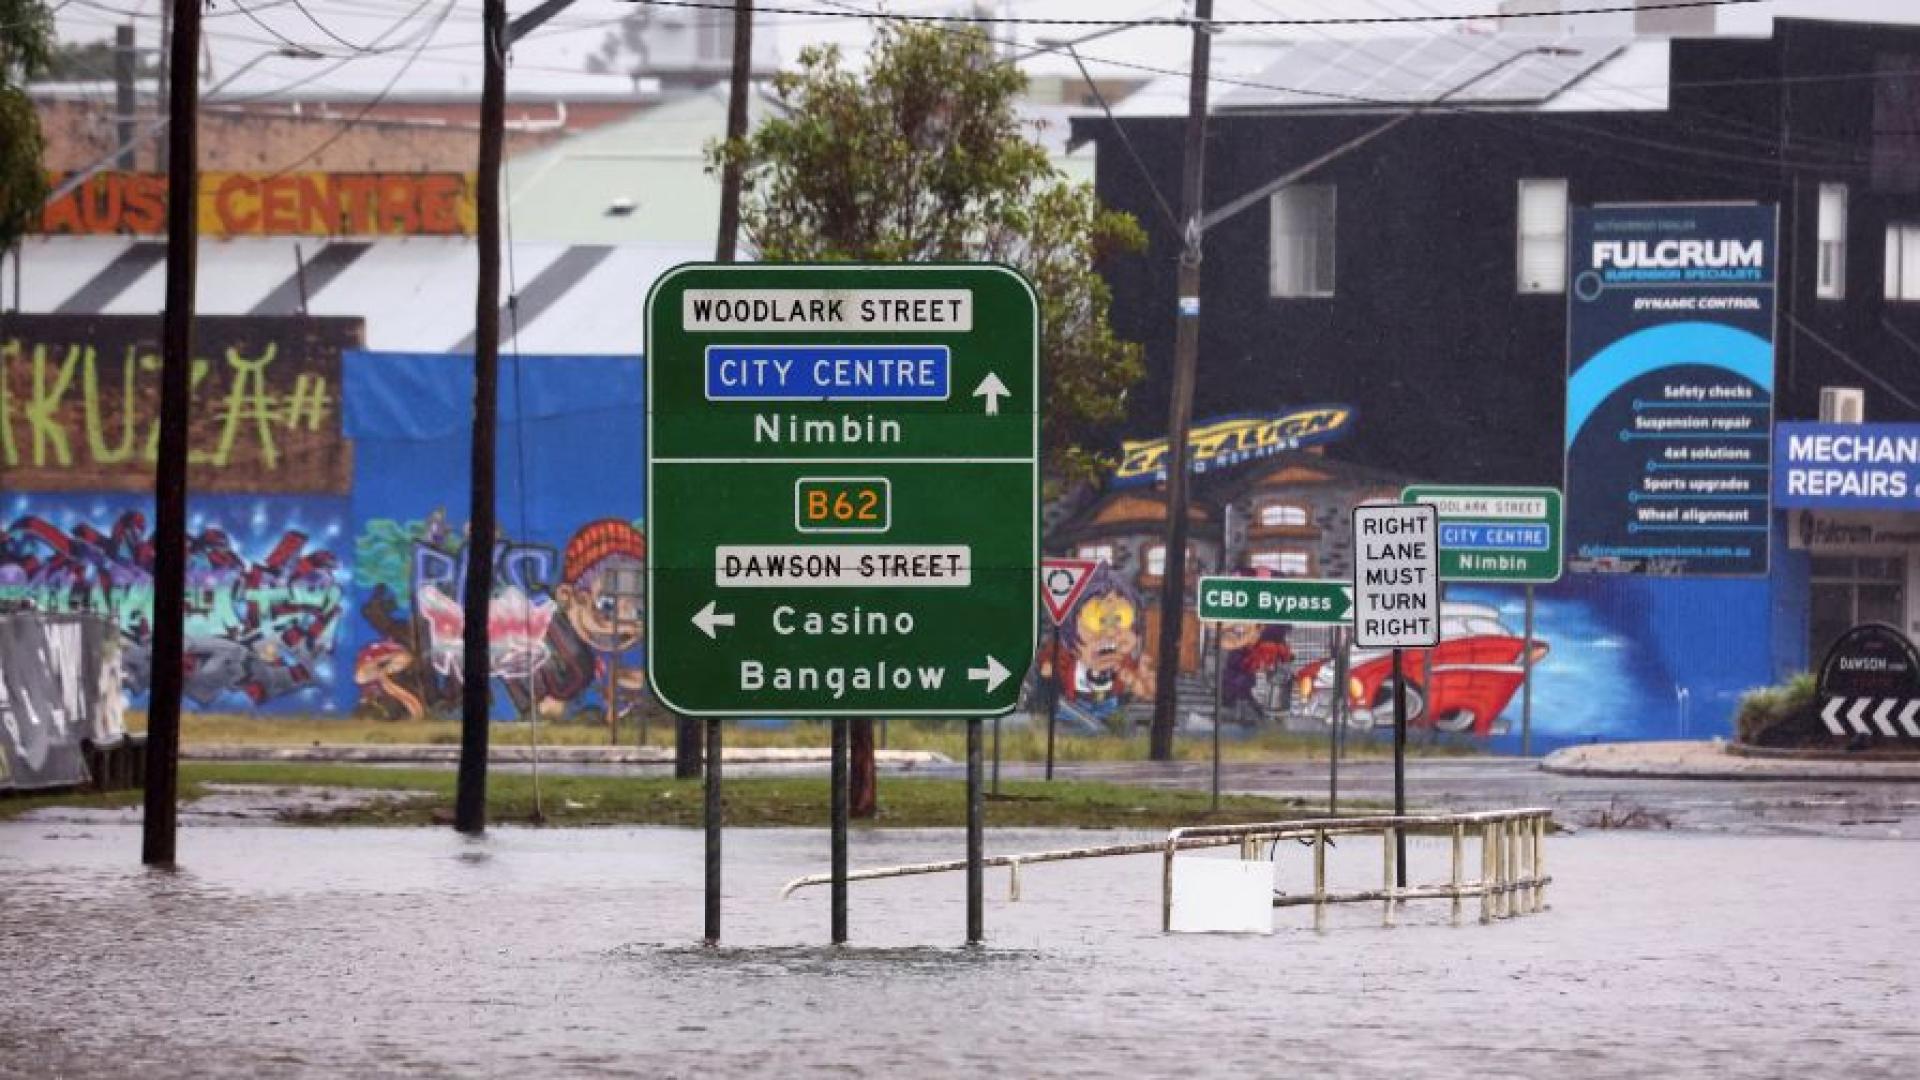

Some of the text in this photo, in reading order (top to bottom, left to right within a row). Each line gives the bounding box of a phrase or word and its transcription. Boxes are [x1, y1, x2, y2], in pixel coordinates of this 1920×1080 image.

[214, 172, 460, 234] CENTRE
[1592, 239, 1763, 268] FULCRUM
[693, 298, 963, 323] WOODLARK STREET
[1633, 297, 1760, 310] DYNAMIC CONTROL
[719, 359, 936, 387] CITY CENTRE
[1664, 385, 1752, 401] Safety checks
[754, 413, 901, 443] Nimbin
[1634, 415, 1752, 431] Suspension repair
[1664, 447, 1750, 460] 4x4 solutions
[1788, 434, 1920, 464] MECHAN
[1643, 477, 1749, 493] Sports upgrades
[1788, 469, 1907, 498] REPAIRS
[807, 490, 879, 521] B62
[1436, 501, 1543, 513] ODLARK STREET
[1637, 508, 1749, 523] Wheel alignment
[1363, 516, 1428, 535] RIGHT
[1443, 528, 1543, 543] CITY CENTRE
[1366, 541, 1428, 560] LANE
[725, 554, 963, 577] DAWSON STREET
[1458, 554, 1527, 571] Nimbin
[1366, 567, 1428, 585] MUST
[1206, 590, 1332, 614] CBD Bypass
[1366, 592, 1426, 611] TURN
[772, 605, 915, 635] Casino
[1365, 616, 1430, 636] RIGHT
[1840, 657, 1887, 670] DAWSON
[740, 660, 946, 699] Bangalow
